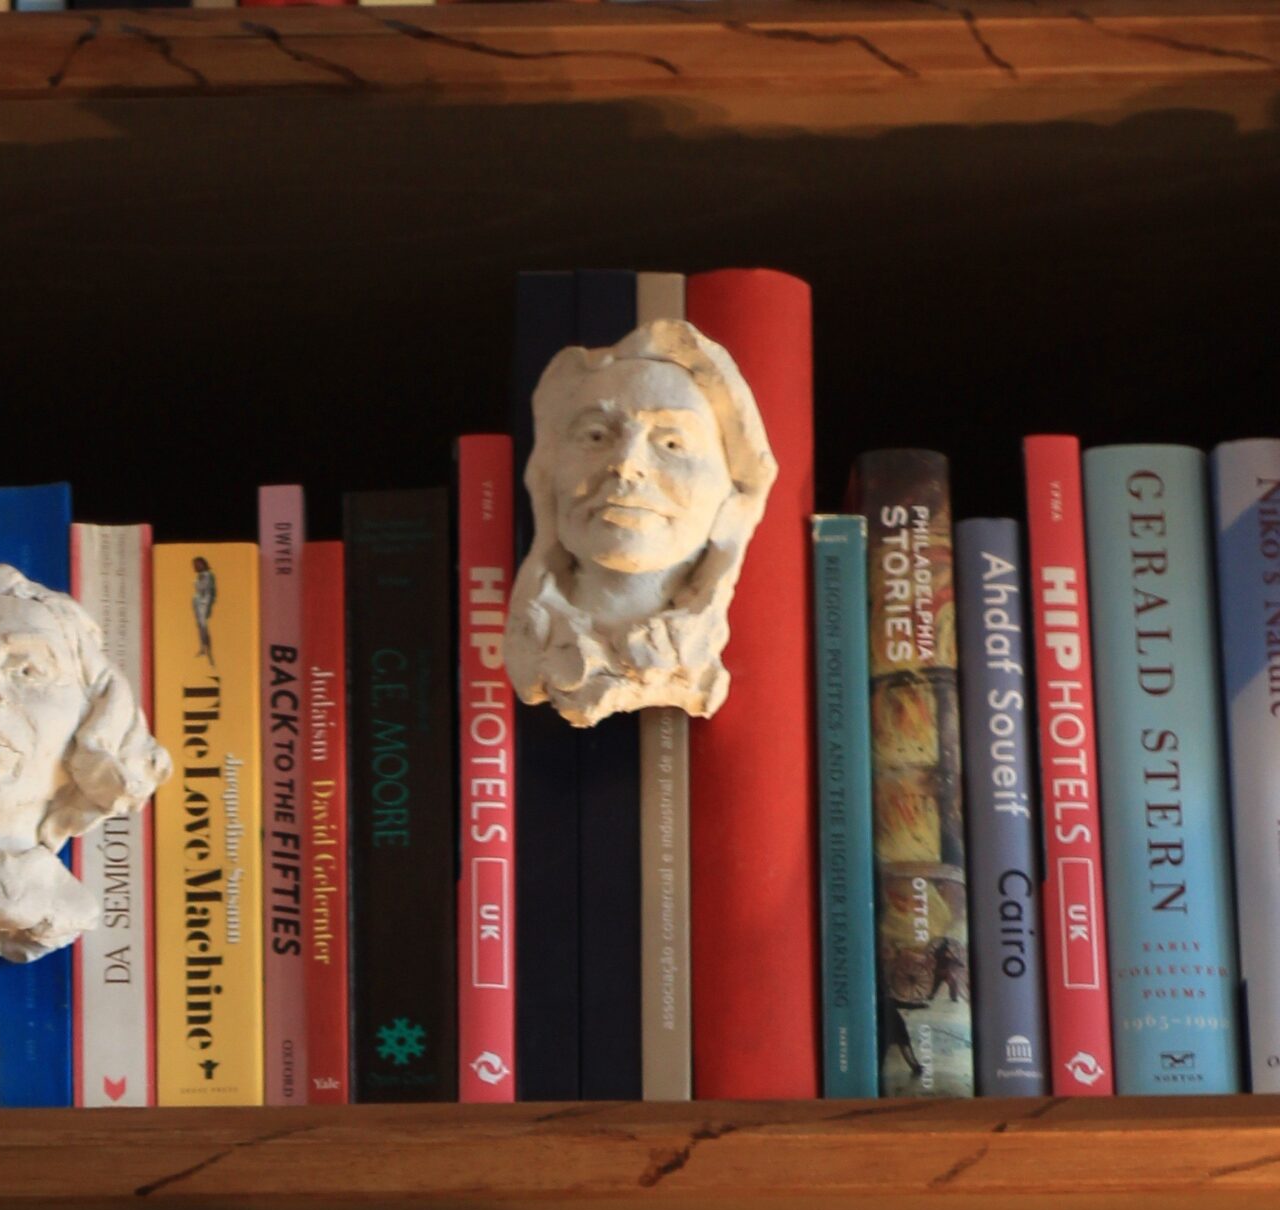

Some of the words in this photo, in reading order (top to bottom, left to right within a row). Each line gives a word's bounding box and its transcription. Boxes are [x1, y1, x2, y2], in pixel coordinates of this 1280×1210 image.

[274, 521, 293, 576] DWYER
[880, 505, 915, 664] STORIES
[911, 505, 936, 661] PHILADELPHIA
[1126, 469, 1178, 698] GERALD
[469, 566, 505, 669] HIP
[823, 556, 842, 641] RELIGION
[980, 551, 1025, 676] Ahdaf
[183, 676, 222, 757] The
[269, 644, 300, 735] BACK
[309, 667, 336, 762] Judaism
[825, 649, 844, 732] POLITICS
[273, 740, 296, 773] TO
[469, 680, 507, 844] HOTELS
[828, 741, 846, 782] AND
[986, 689, 1032, 818] Soueif
[183, 766, 223, 861] Love
[273, 779, 297, 823] THE
[311, 779, 338, 846] David
[829, 788, 847, 827] THE
[1140, 728, 1190, 915] STERN
[271, 830, 301, 957] FIFTIES
[311, 853, 338, 964] Gelernter
[830, 832, 849, 905] HIGHER
[912, 877, 930, 943] OTTER
[104, 945, 132, 985] DA
[182, 869, 224, 1050] Machine
[832, 912, 851, 1008] LEARNING
[997, 870, 1035, 978] Cairo
[281, 1039, 296, 1097] OXFORD
[838, 1027, 850, 1073] HARVARD
[919, 1024, 934, 1089] OXFORD
